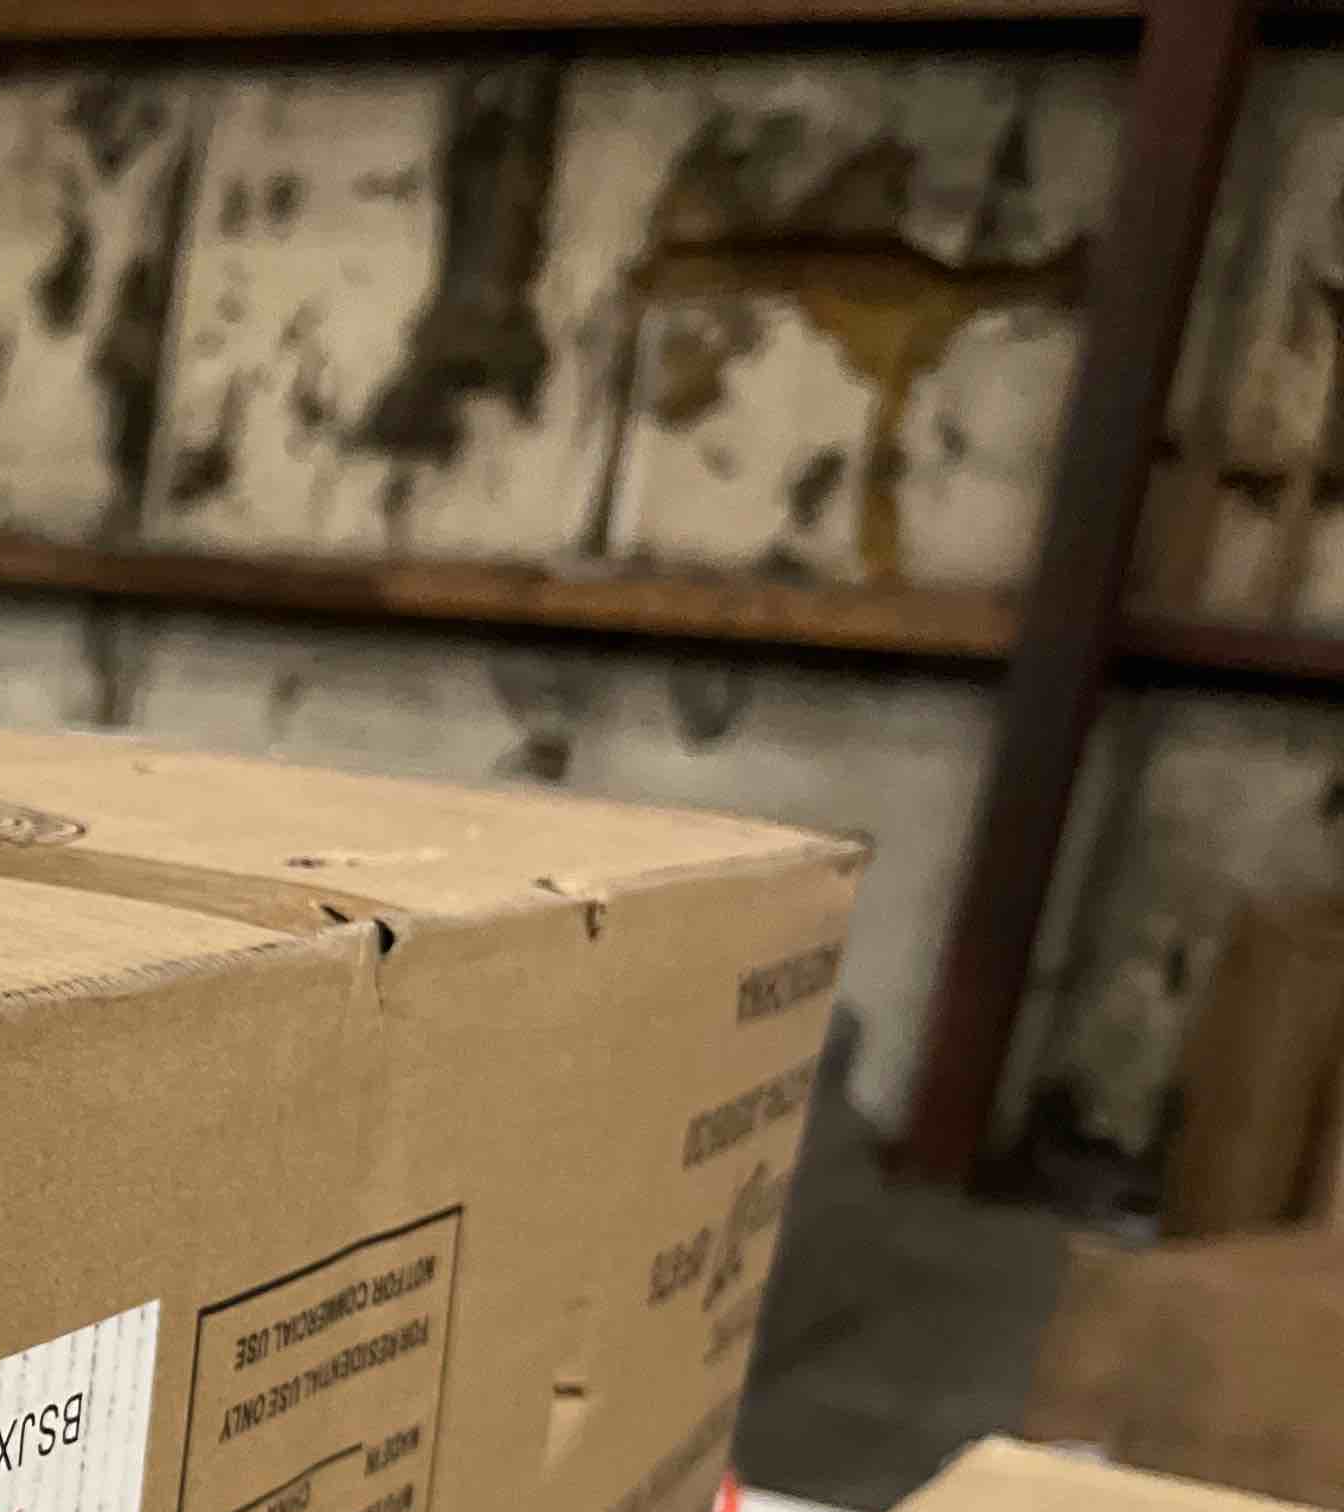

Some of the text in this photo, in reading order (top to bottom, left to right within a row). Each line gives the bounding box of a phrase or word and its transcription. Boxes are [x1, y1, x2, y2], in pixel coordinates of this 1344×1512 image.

[370, 1269, 404, 1310] FOR
[274, 1280, 368, 1356] COMMERCIAL
[233, 1328, 269, 1371] USE
[304, 1331, 399, 1395] RESIDENTIAL
[219, 1387, 266, 1443] ONLY
[265, 1377, 301, 1420] USE
